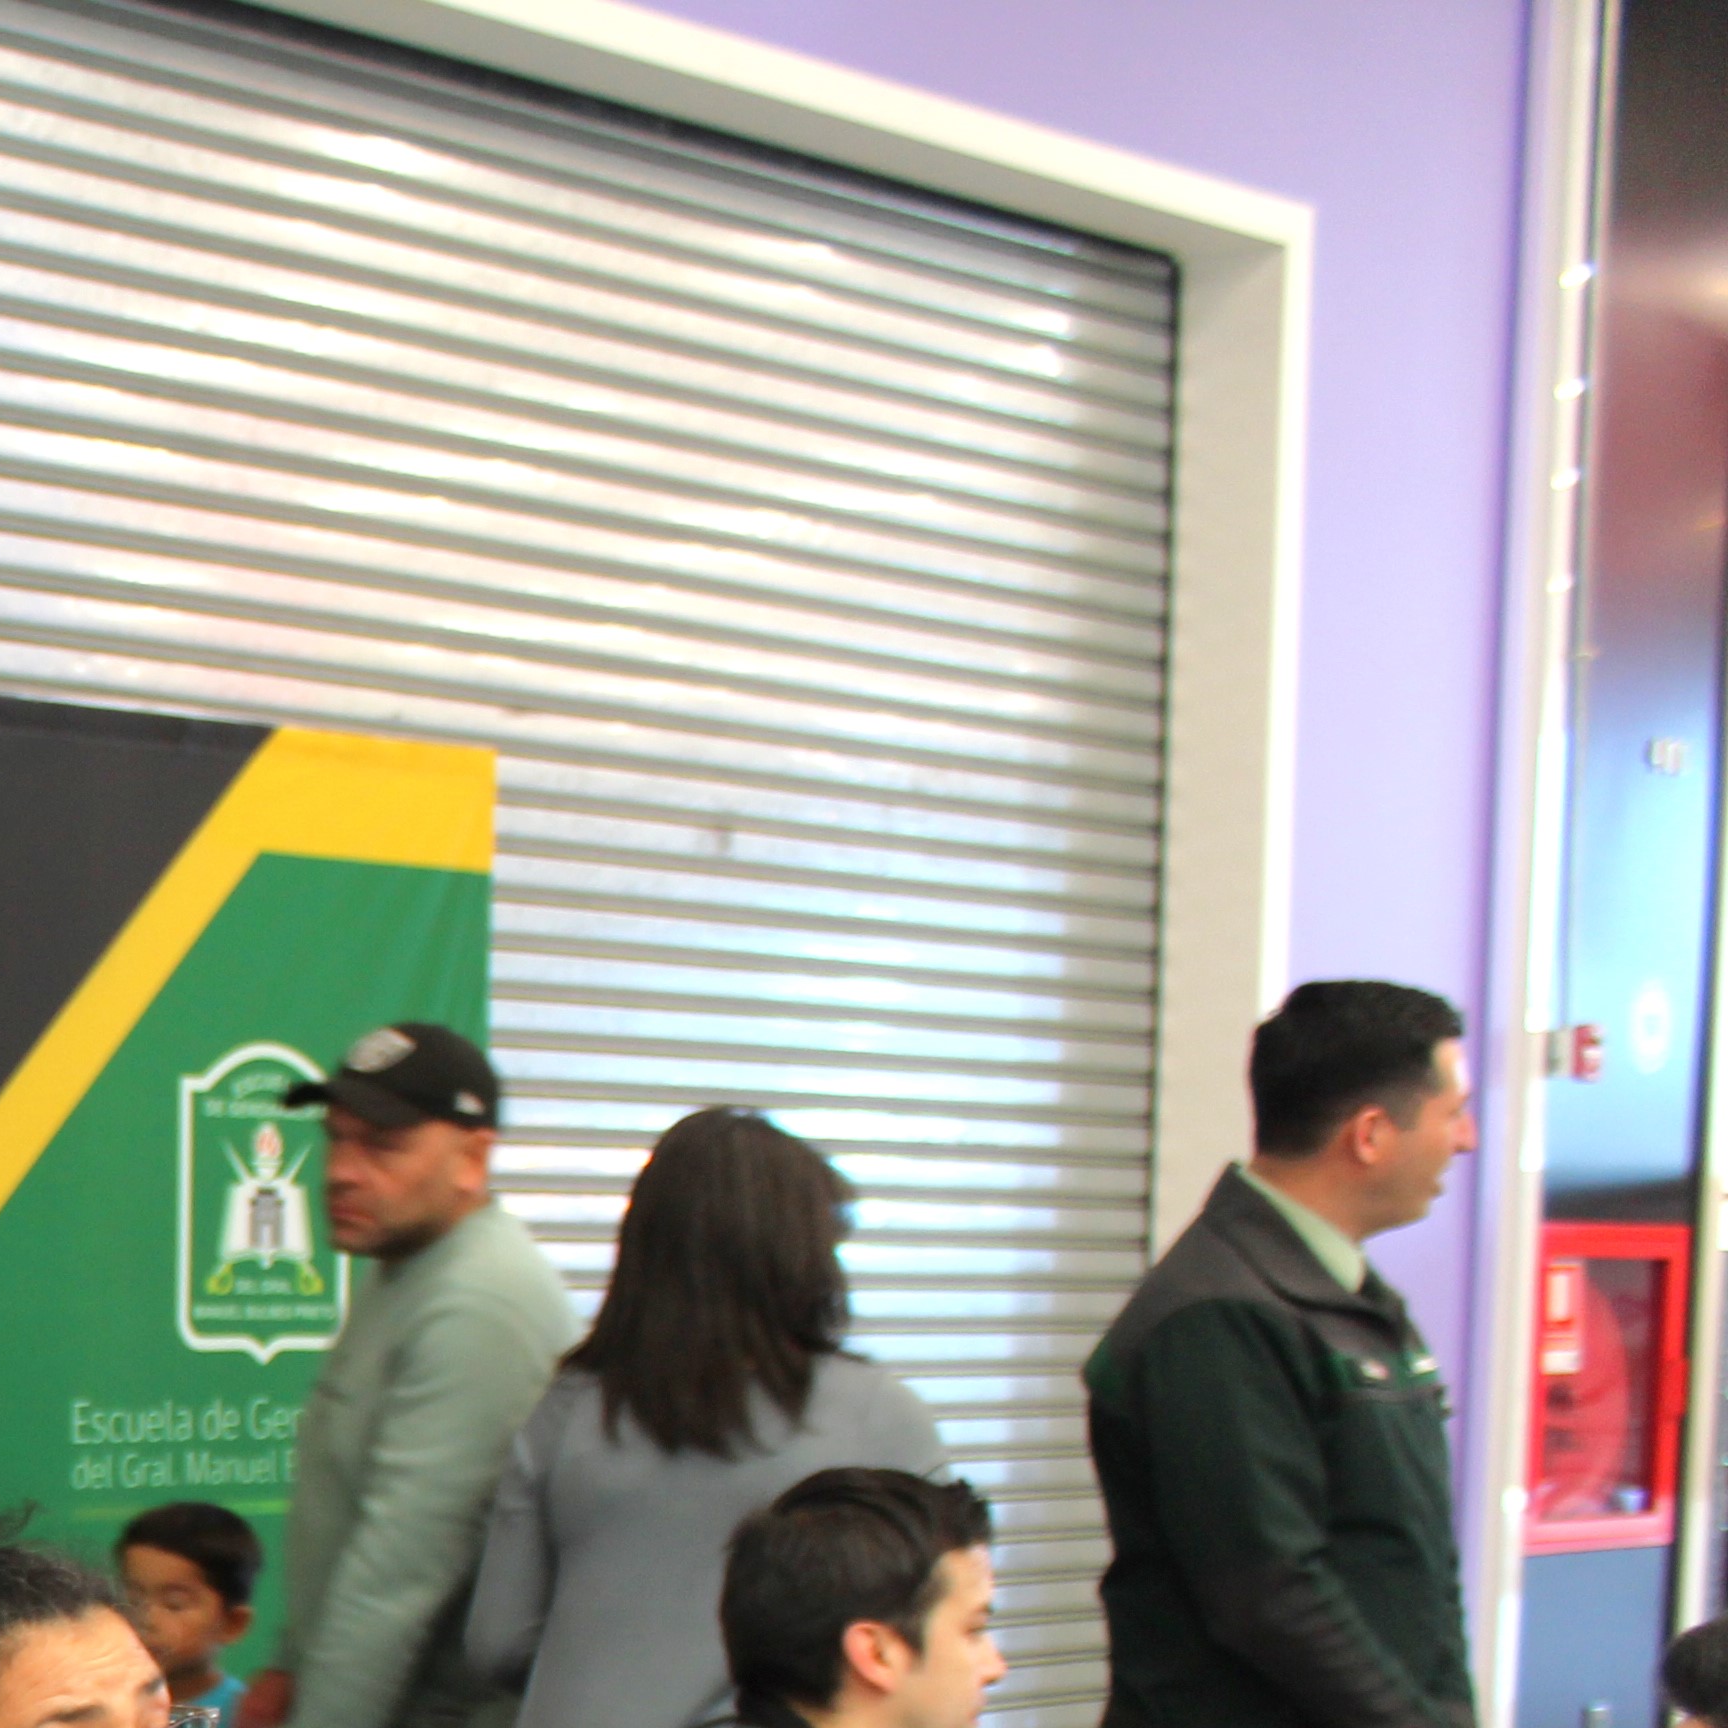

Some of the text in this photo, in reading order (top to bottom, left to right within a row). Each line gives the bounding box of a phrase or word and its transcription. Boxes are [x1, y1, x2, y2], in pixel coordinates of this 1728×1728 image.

[70, 1400, 194, 1445] Escuela
[201, 1400, 241, 1441] de
[71, 1454, 112, 1490] del
[186, 1450, 277, 1486] Manuel
